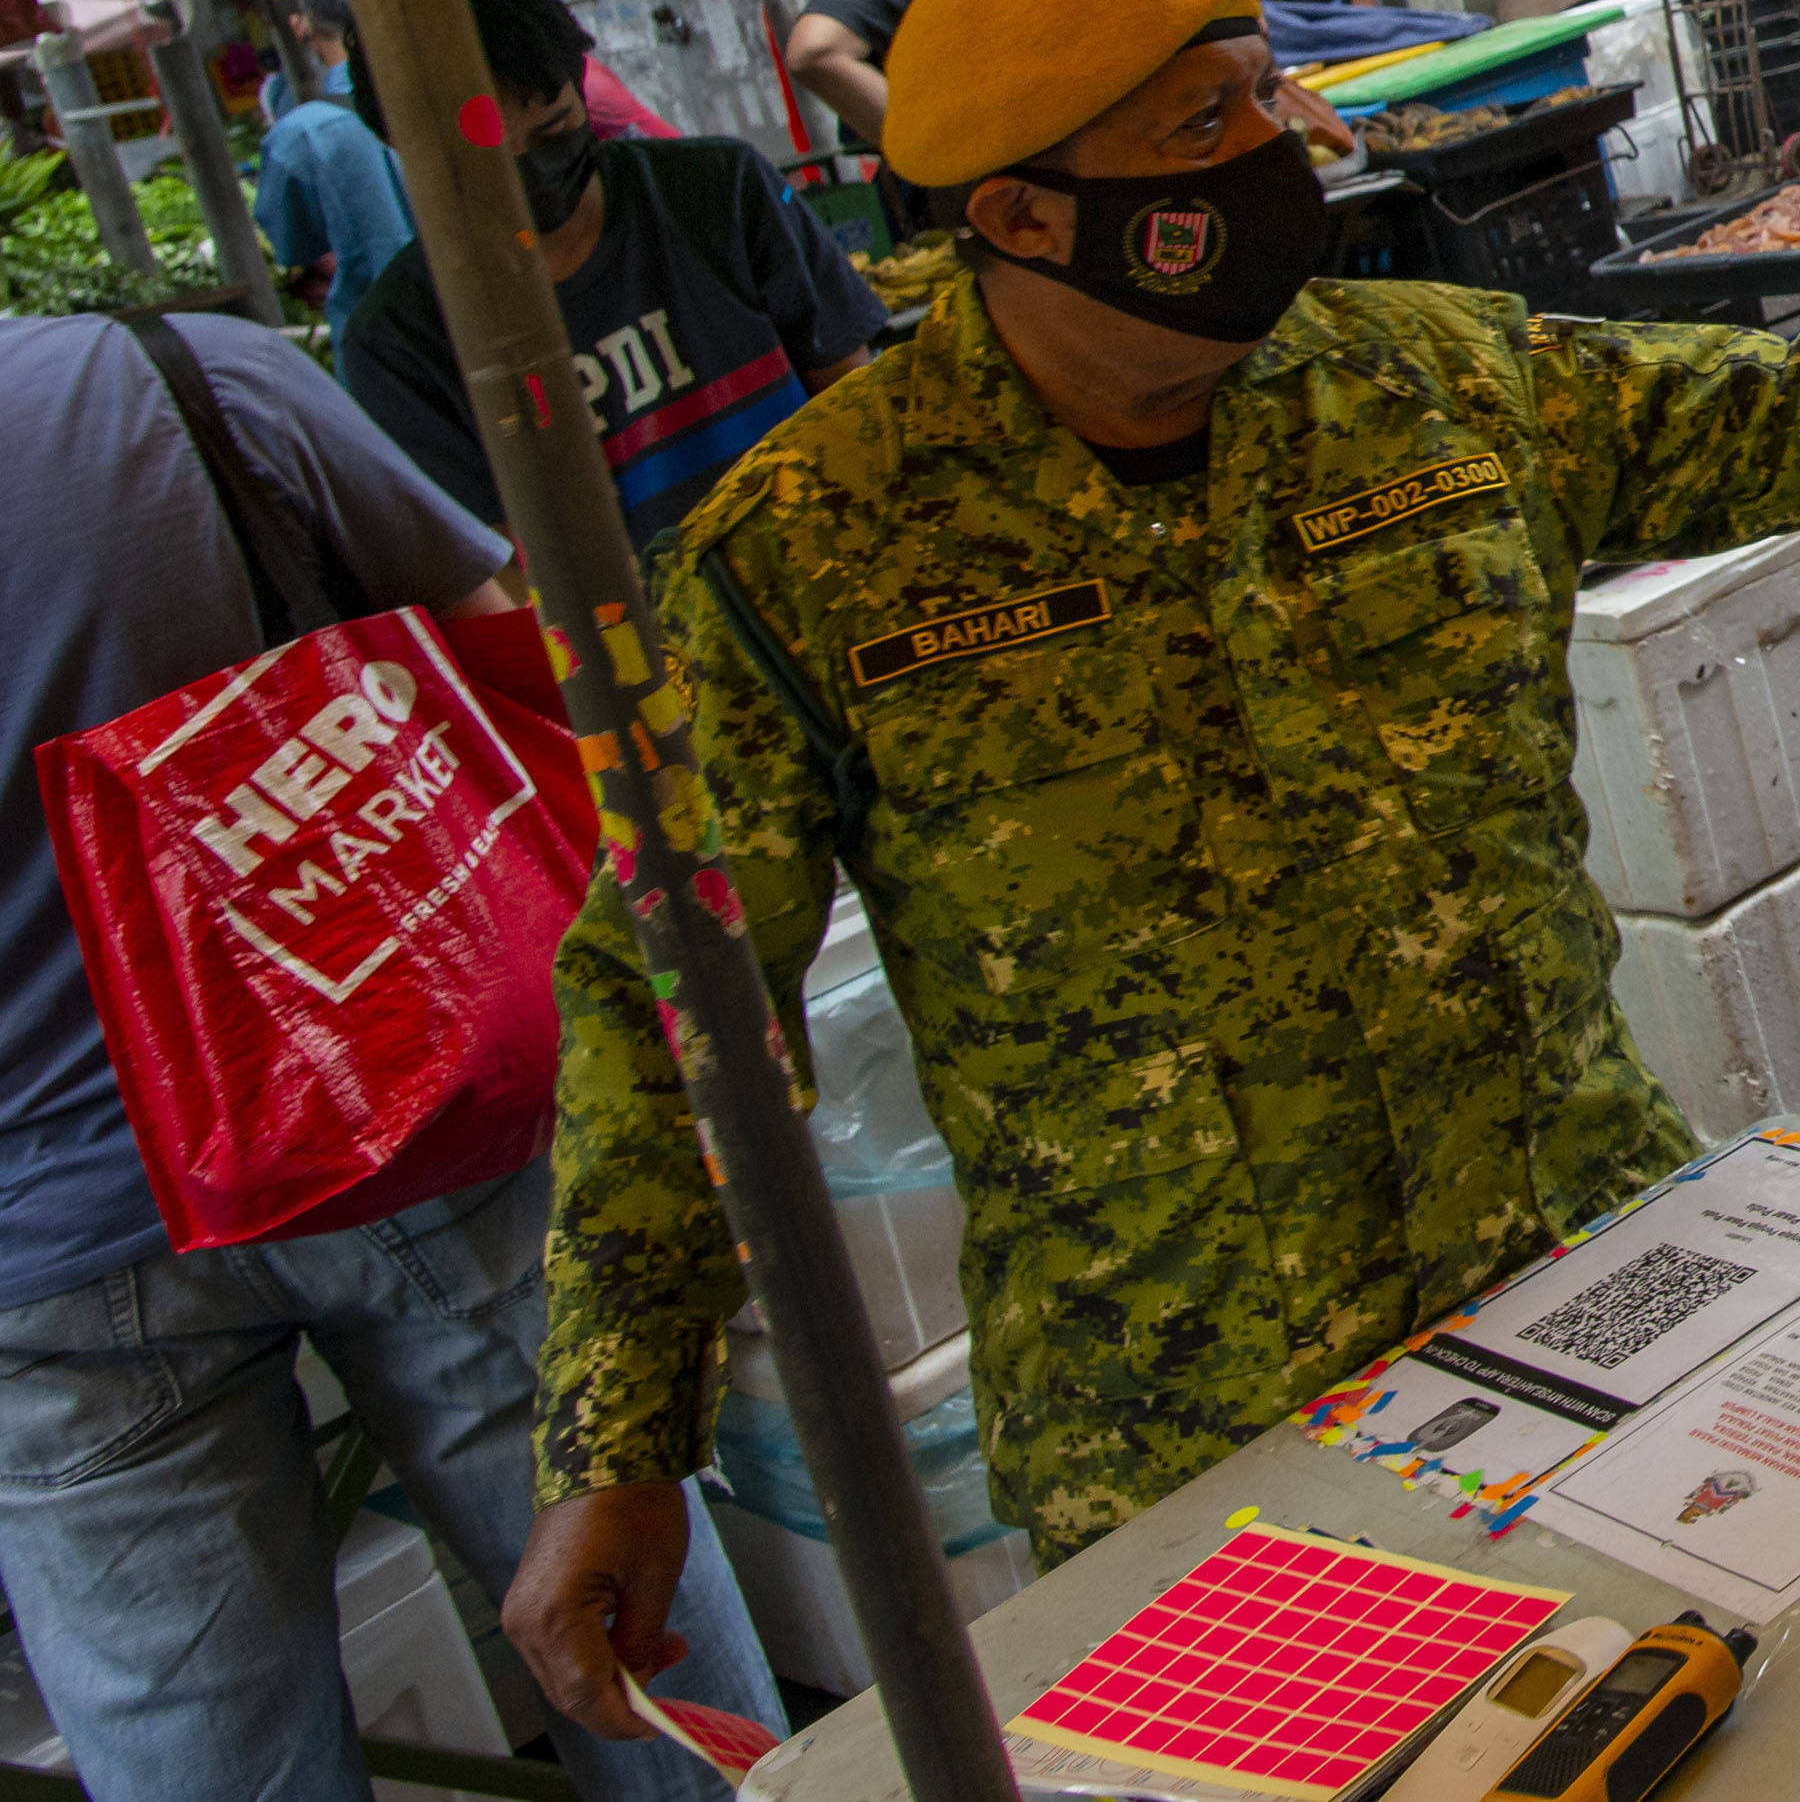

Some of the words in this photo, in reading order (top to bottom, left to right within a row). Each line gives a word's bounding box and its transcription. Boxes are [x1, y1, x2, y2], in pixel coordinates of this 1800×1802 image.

[1304, 460, 1500, 542] WP-002-0300
[910, 600, 1051, 658] BAHARI
[190, 660, 418, 879] HERO
[266, 720, 461, 926] MARKET
[400, 862, 472, 933] FRESH
[1458, 1359, 1484, 1373] TO
[1472, 1364, 1503, 1380] APP
[1555, 1395, 1592, 1413] WITH
[1579, 1404, 1618, 1423] SCAN
[1750, 1412, 1788, 1430] KUALA
[1685, 1427, 1722, 1445] PASAR
[1746, 1438, 1784, 1456] PASAR
